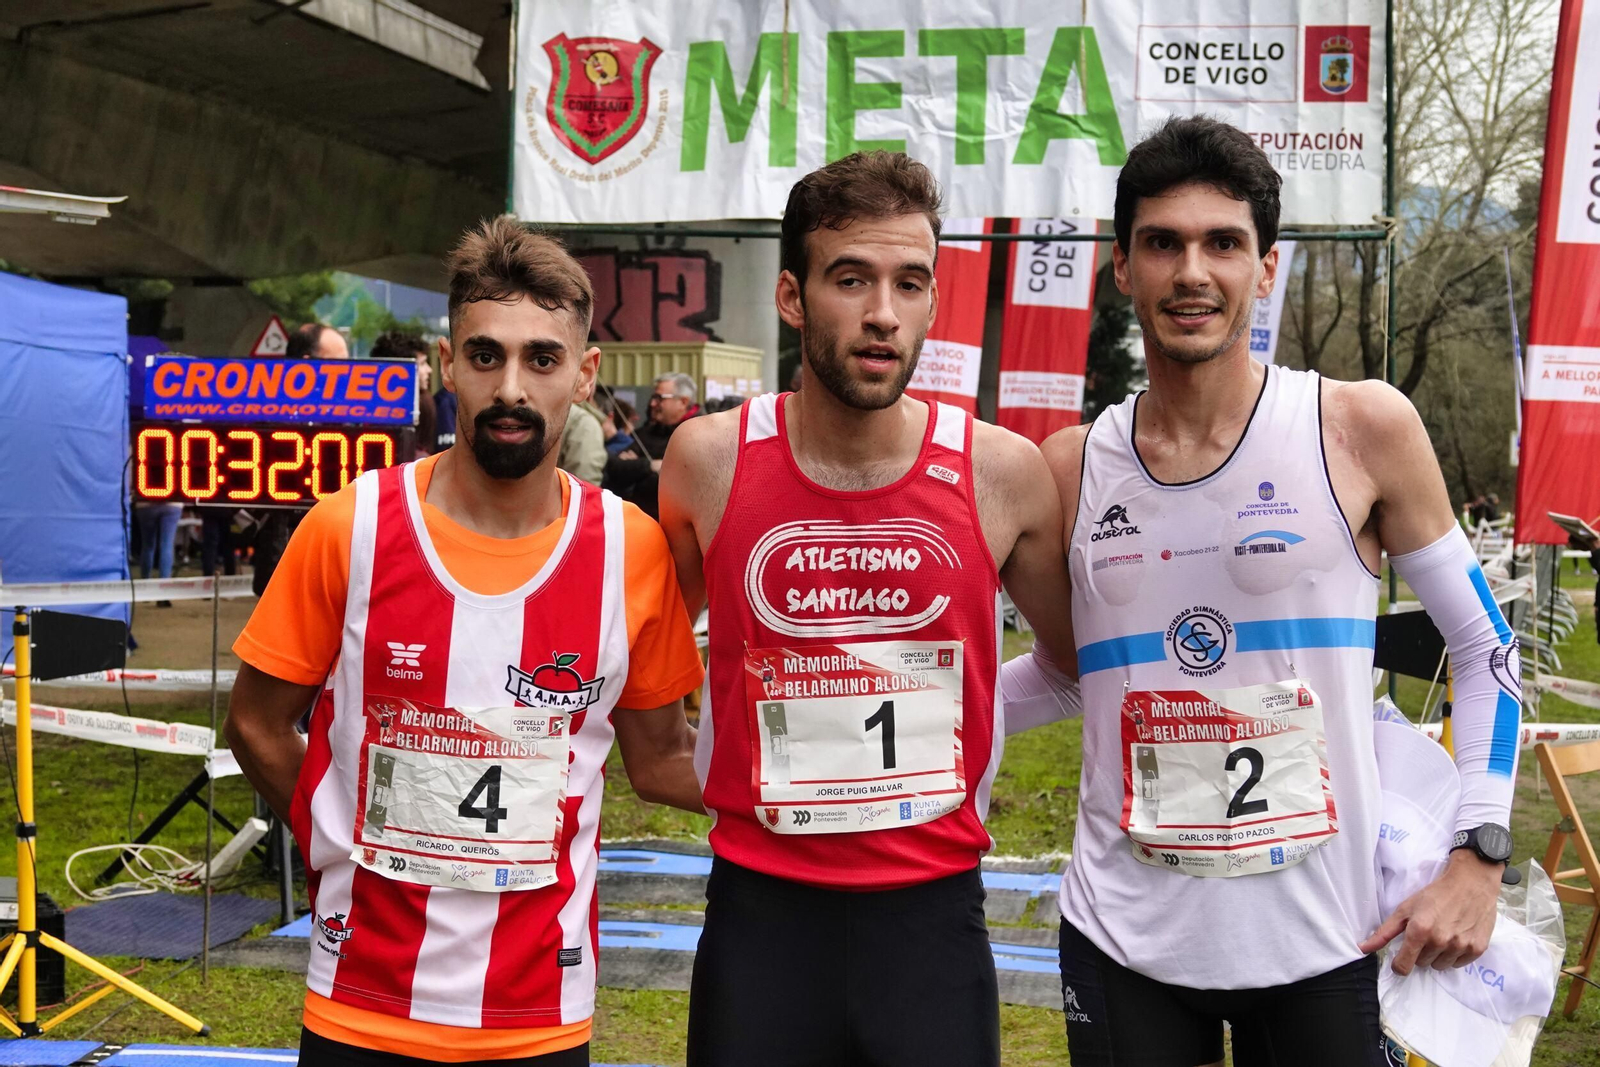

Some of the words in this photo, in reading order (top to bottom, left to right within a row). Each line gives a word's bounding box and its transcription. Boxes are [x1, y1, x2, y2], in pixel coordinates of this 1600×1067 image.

[1149, 42, 1285, 61] CONCELLO
[1164, 67, 1197, 85] DE
[1205, 67, 1268, 85] VIGO
[680, 26, 1127, 172] META
[1248, 127, 1363, 151] PUTACIÓN
[1055, 246, 1076, 278] DE
[153, 361, 410, 401] CRONOTEC
[1542, 370, 1550, 379] A
[155, 403, 406, 419] WWW.CRONOTEC.ES
[1237, 508, 1299, 519] PONTEVEDRA
[785, 546, 922, 573] ATLETISMO
[1108, 553, 1143, 563] DEPUTACIÓN
[1174, 548, 1204, 557] Xacobeo
[786, 587, 910, 614] SANTIAGO
[1166, 608, 1191, 642] SOCIEDAD
[1193, 605, 1233, 635] GIMNÁSTICA
[900, 651, 934, 659] CONCELLO
[784, 653, 863, 674] MEMORIAL
[1178, 661, 1227, 678] PONTEVEDRA
[386, 666, 423, 681] belma
[785, 677, 869, 698] BELARMINO
[875, 673, 928, 692] ALONSO
[1261, 692, 1294, 703] CONCELLO
[1275, 699, 1290, 707] VIGO
[1151, 701, 1225, 718] MEMORIAL
[400, 707, 477, 733] MEMORIAL
[1153, 723, 1231, 741] BELARMINO
[1236, 714, 1290, 739] ALONSO
[865, 700, 897, 770] 1
[396, 731, 480, 757] BELARMINO
[484, 740, 539, 757] ALONSO
[816, 788, 845, 797] JORGE
[847, 786, 868, 795] PUIG
[870, 783, 903, 793] MALVAR
[1224, 746, 1269, 819] 2
[458, 765, 507, 833] 4
[914, 800, 941, 809] XUNTA
[813, 809, 848, 817] Deputación
[914, 810, 923, 818] DE
[1178, 833, 1214, 842] CARLOS
[1217, 832, 1244, 841] PORTO
[1246, 827, 1276, 837] PAZOS
[416, 839, 454, 852] RICARDO
[461, 845, 500, 856] QUEIRÓS
[1286, 843, 1314, 854] XUNTA
[408, 861, 441, 871] Deputación
[1286, 854, 1297, 862] DE
[408, 866, 440, 876] Pontevedra
[509, 869, 534, 877] XUNTA
[509, 877, 519, 885] DE
